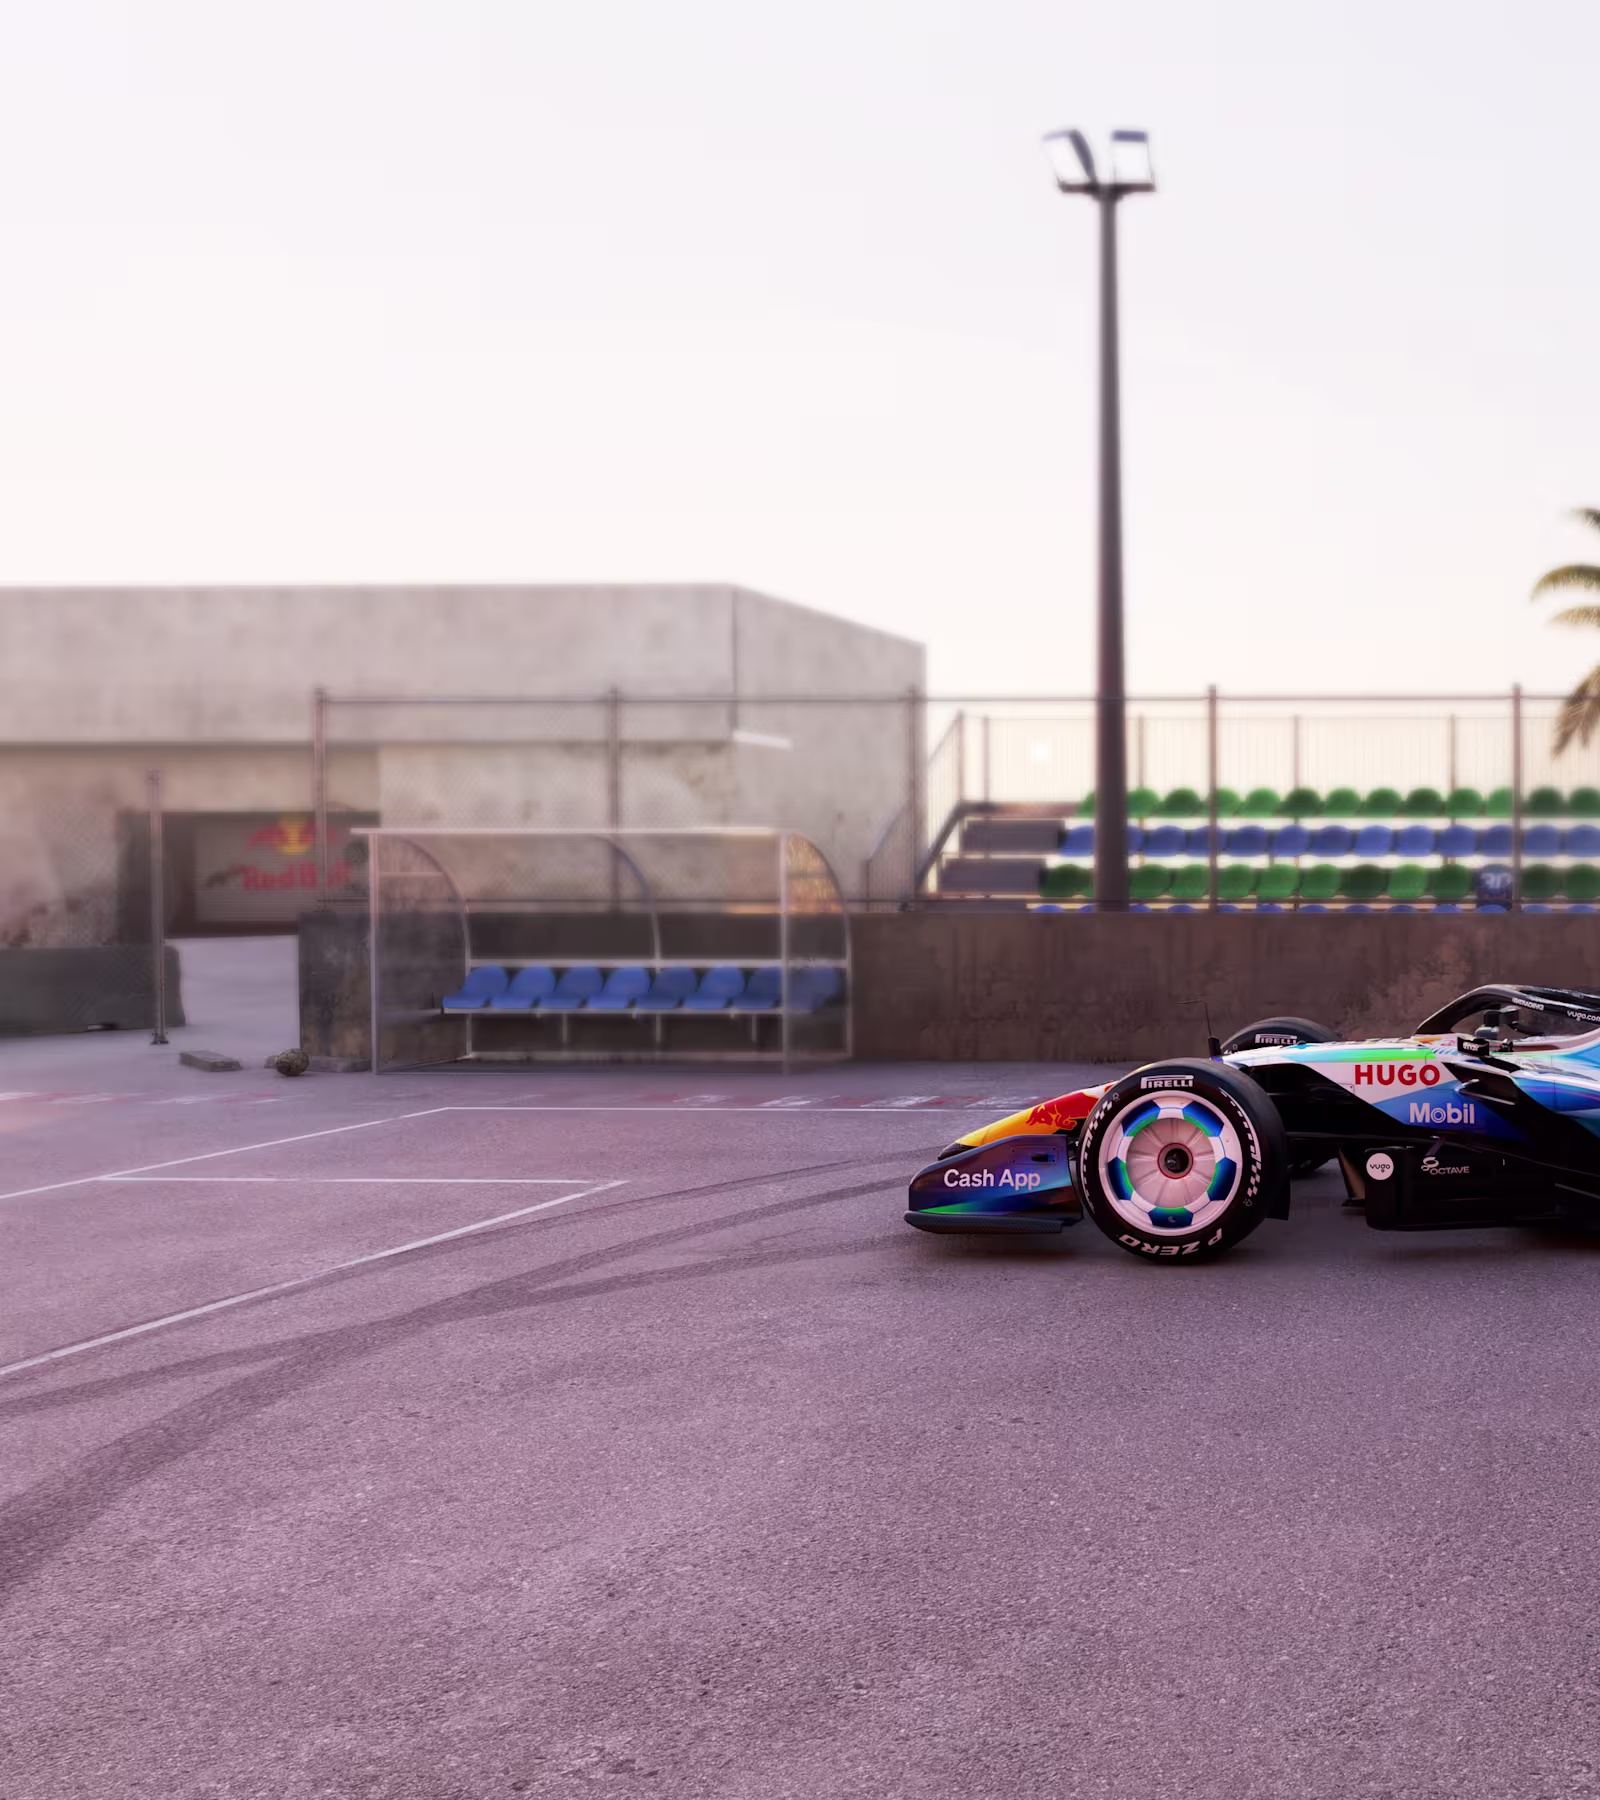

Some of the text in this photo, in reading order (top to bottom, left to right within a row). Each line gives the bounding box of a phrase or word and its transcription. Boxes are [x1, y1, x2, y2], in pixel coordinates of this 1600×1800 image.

[1254, 1033, 1298, 1046] PIRELLI
[1140, 1074, 1195, 1090] PIRELLI
[1354, 1064, 1440, 1086] HUGO
[1409, 1102, 1475, 1125] Mobil
[943, 1168, 1041, 1191] Cash App
[1429, 1165, 1470, 1176] OCTAVE
[1118, 1227, 1223, 1256] P ZERO
